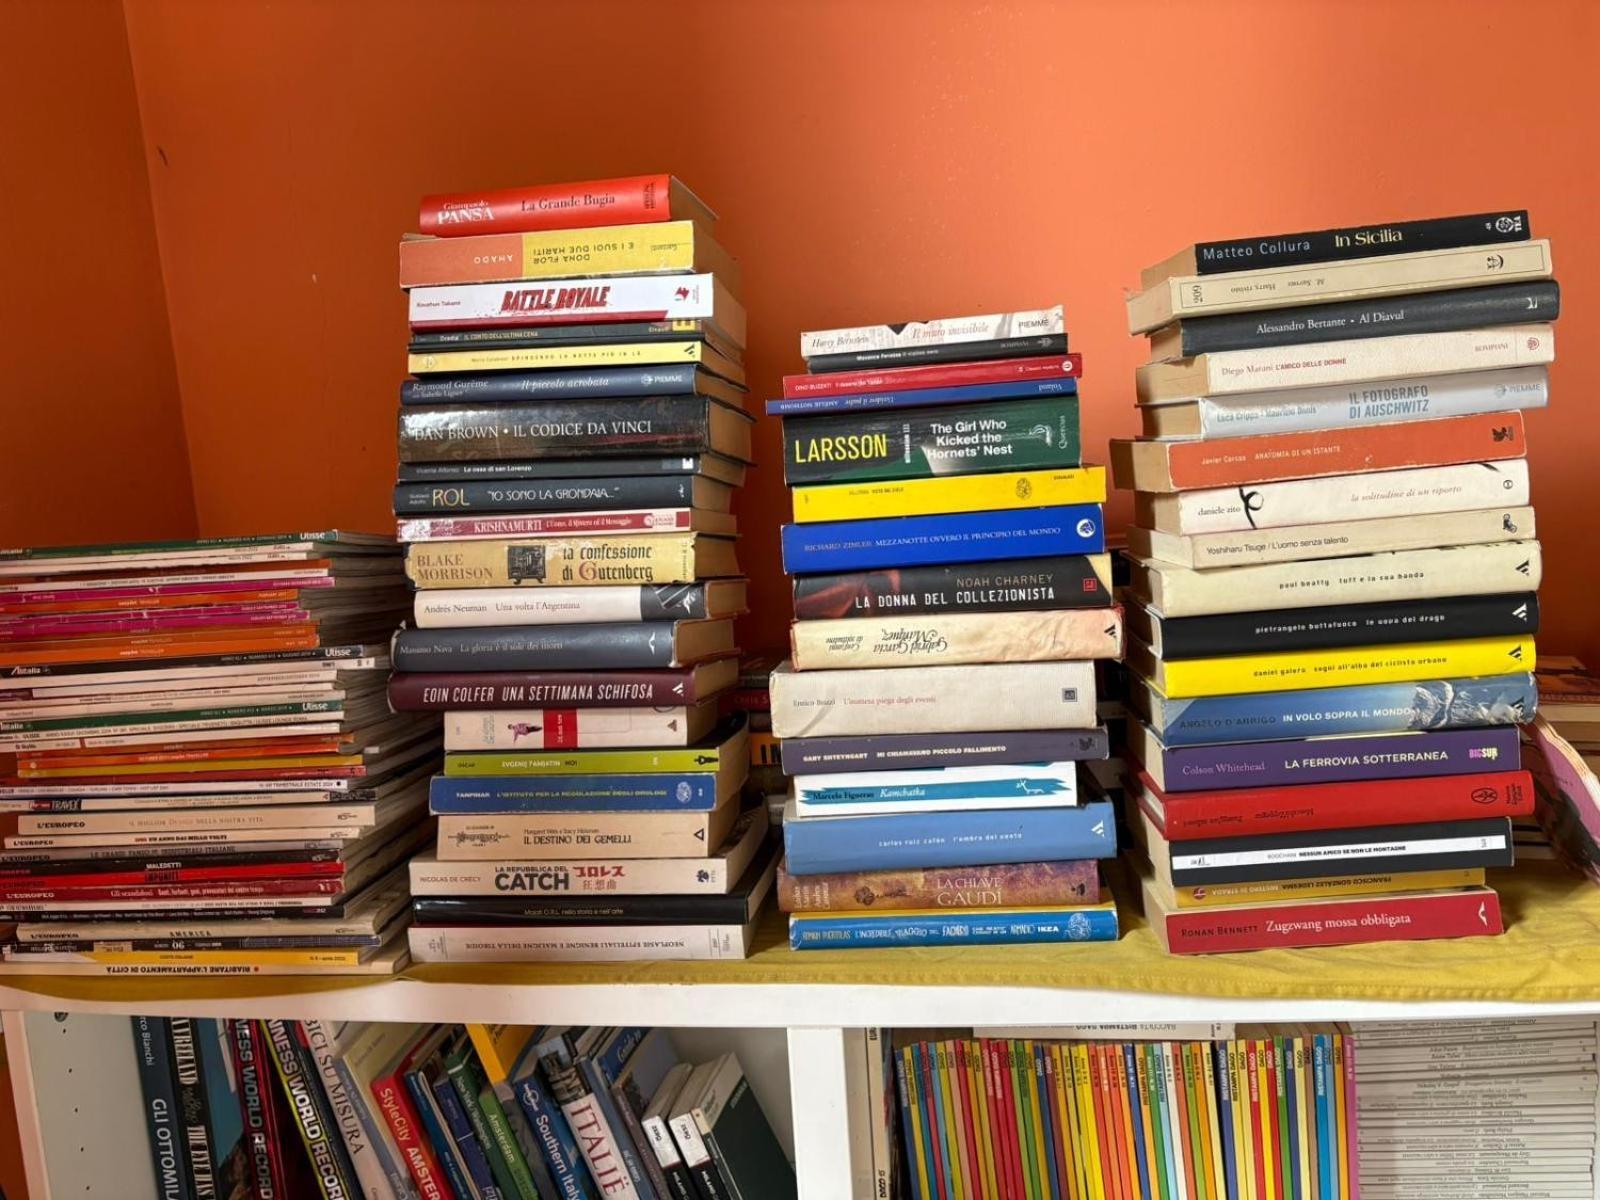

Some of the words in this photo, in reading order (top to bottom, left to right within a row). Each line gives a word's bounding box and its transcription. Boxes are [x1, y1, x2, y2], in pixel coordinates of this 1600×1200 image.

[521, 200, 535, 211] La
[539, 195, 581, 209] Grande
[583, 192, 616, 208] Bugia
[437, 206, 494, 224] PANSA
[1203, 246, 1253, 260] Matteo
[1259, 240, 1311, 255] Collura
[1335, 234, 1351, 247] In
[1355, 229, 1402, 246] Sicilia
[473, 255, 513, 264] AMADO
[500, 288, 556, 312] BATTLE
[554, 286, 611, 310] ROYALE
[1018, 318, 1049, 328] PIEMME
[1257, 320, 1304, 334] Alessandro
[1308, 316, 1346, 328] Bertante
[1360, 313, 1370, 323] Al
[1373, 310, 1404, 323] Diavul
[812, 337, 835, 349] Harry
[837, 334, 870, 346] Bernstein
[1222, 367, 1244, 377] Diego
[1247, 365, 1273, 373] Marani
[1275, 362, 1301, 371] L'AMICO
[1303, 360, 1322, 368] DELLE
[1324, 358, 1347, 366] DONNE
[412, 382, 452, 393] Raymond
[521, 380, 531, 389] Il
[531, 380, 564, 392] piccolo
[567, 377, 609, 388] acrobata
[654, 375, 683, 383] PIEMME
[1509, 383, 1540, 393] PIEMME
[1349, 393, 1357, 404] IL
[1363, 385, 1428, 402] FOTOGRAFO
[1350, 406, 1361, 419] DI
[1364, 400, 1429, 418] AUSCHWITZ
[415, 426, 443, 440] DAN
[448, 425, 498, 439] BROWN
[513, 424, 527, 437] IL
[530, 423, 583, 437] CODICE
[587, 421, 607, 435] DA
[611, 420, 651, 434] VINCI
[930, 423, 953, 434] The
[955, 421, 977, 433] Girl
[979, 419, 1007, 431] Who
[795, 434, 886, 463] LARSSON
[936, 434, 979, 446] Kicked
[982, 433, 1002, 443] the
[927, 447, 981, 459] Hornets'
[984, 444, 1013, 456] Nest
[432, 488, 470, 506] ROL
[507, 490, 536, 500] SONO
[539, 489, 551, 500] LA
[1198, 507, 1225, 516] daniele
[1207, 545, 1242, 555] Yoshiharu
[1245, 543, 1266, 553] Tsuge
[1272, 541, 1298, 550] L'uomo
[1300, 539, 1322, 548] senza
[1324, 536, 1348, 545] talento
[417, 554, 463, 566] BLAKE
[417, 567, 494, 580] MORRISON
[562, 565, 573, 580] di
[579, 560, 653, 582] Gutenberg
[957, 577, 989, 588] NOAH
[995, 574, 1053, 586] CHARNEY
[1279, 582, 1298, 590] paul
[1301, 579, 1330, 588] beatty
[1397, 571, 1424, 579] banda
[856, 597, 870, 609] LA
[879, 594, 916, 608] DONNA
[925, 592, 947, 606] DEL
[957, 587, 1054, 604] COLLEZIONISTA
[325, 648, 350, 657] Ulisse
[424, 688, 449, 703] EOIN
[453, 687, 494, 702] COLFER
[502, 686, 524, 701] UNA
[529, 684, 593, 701] SETTIMANA
[597, 684, 653, 699] SCHIFOSA
[302, 702, 328, 711] Ulisse
[1179, 718, 1221, 729] ANGELO
[1226, 716, 1276, 726] D'ARRIGO
[1283, 714, 1293, 722] IN
[1295, 712, 1322, 722] VOLO
[1325, 711, 1358, 720] SOPRA
[1361, 710, 1370, 718] IL
[1373, 707, 1412, 717] MONDO
[887, 749, 930, 757] CHIAMAVANO
[963, 745, 1007, 753] FALLIMENTO
[1182, 765, 1214, 776] Colson
[1215, 761, 1265, 774] Whitehead
[1285, 760, 1300, 769] LA
[1303, 756, 1360, 768] FERROVIA
[1363, 750, 1449, 764] SOTTERRANEA
[37, 821, 85, 829] L'EUROPEO
[524, 836, 531, 845] IL
[534, 835, 571, 845] DESTINO
[576, 835, 591, 844] DEI
[594, 834, 632, 844] GEMELLI
[495, 873, 569, 891] CATCH
[937, 878, 950, 889] LA
[955, 877, 1001, 888] CHIAVE
[6, 891, 55, 899] L'EUROPEO
[1182, 928, 1214, 937] RONAN
[1217, 926, 1258, 935] BENNETT
[1266, 918, 1322, 934] Zugzwang
[1325, 920, 1357, 929] mossa
[1361, 913, 1411, 928] obbligata
[141, 966, 208, 974] L'APPARTAMENTO
[209, 965, 250, 973] RIABITARE
[142, 1033, 155, 1066] Bianchi
[152, 1098, 171, 1122] GLI
[289, 1077, 321, 1139] WORLD
[319, 1055, 338, 1079] SU
[329, 1083, 364, 1155] MISURA
[379, 1087, 411, 1142] StyleCity
[489, 1113, 515, 1164] Amsterdam
[536, 1115, 567, 1173] Southern
[571, 1103, 630, 1197] ITALIË
